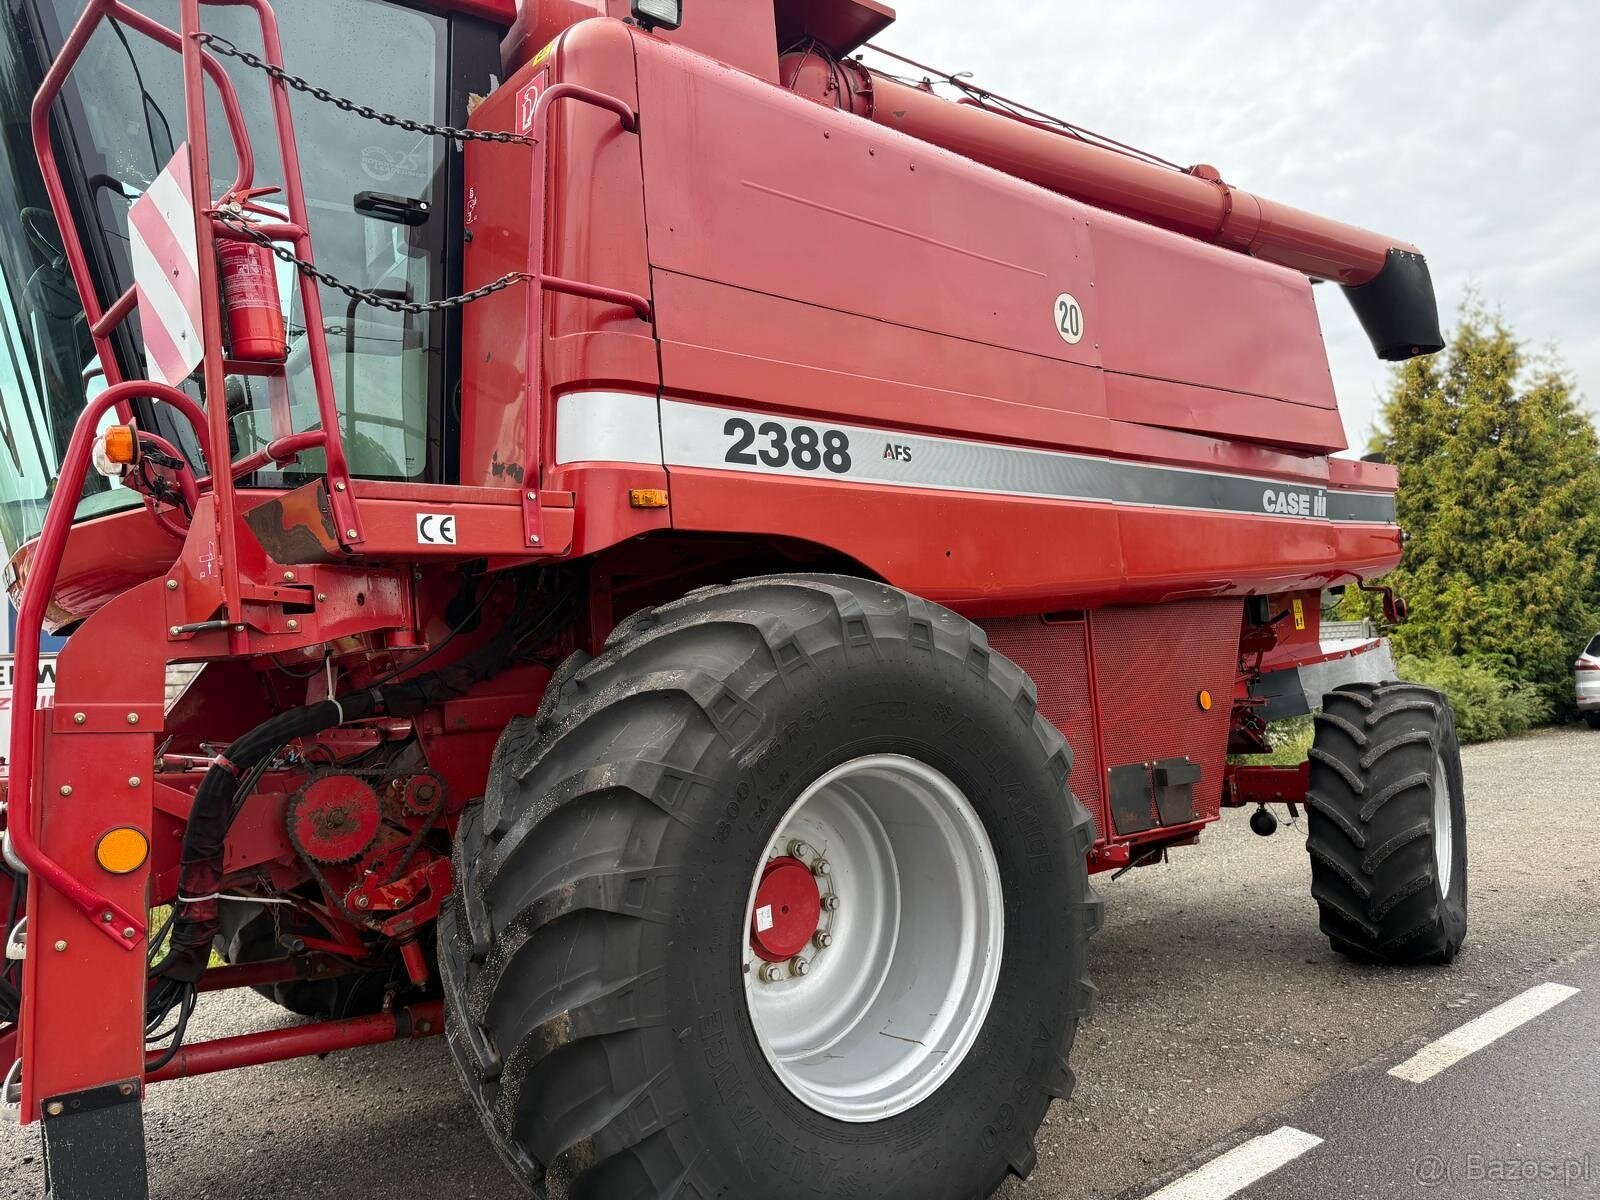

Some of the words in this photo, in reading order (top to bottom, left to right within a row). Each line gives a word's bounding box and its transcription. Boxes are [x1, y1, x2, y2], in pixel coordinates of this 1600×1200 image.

[1059, 300, 1079, 336] 20
[723, 417, 852, 474] 2388
[883, 442, 912, 463] AFS
[1262, 489, 1310, 515] CASE
[420, 515, 454, 543] CE
